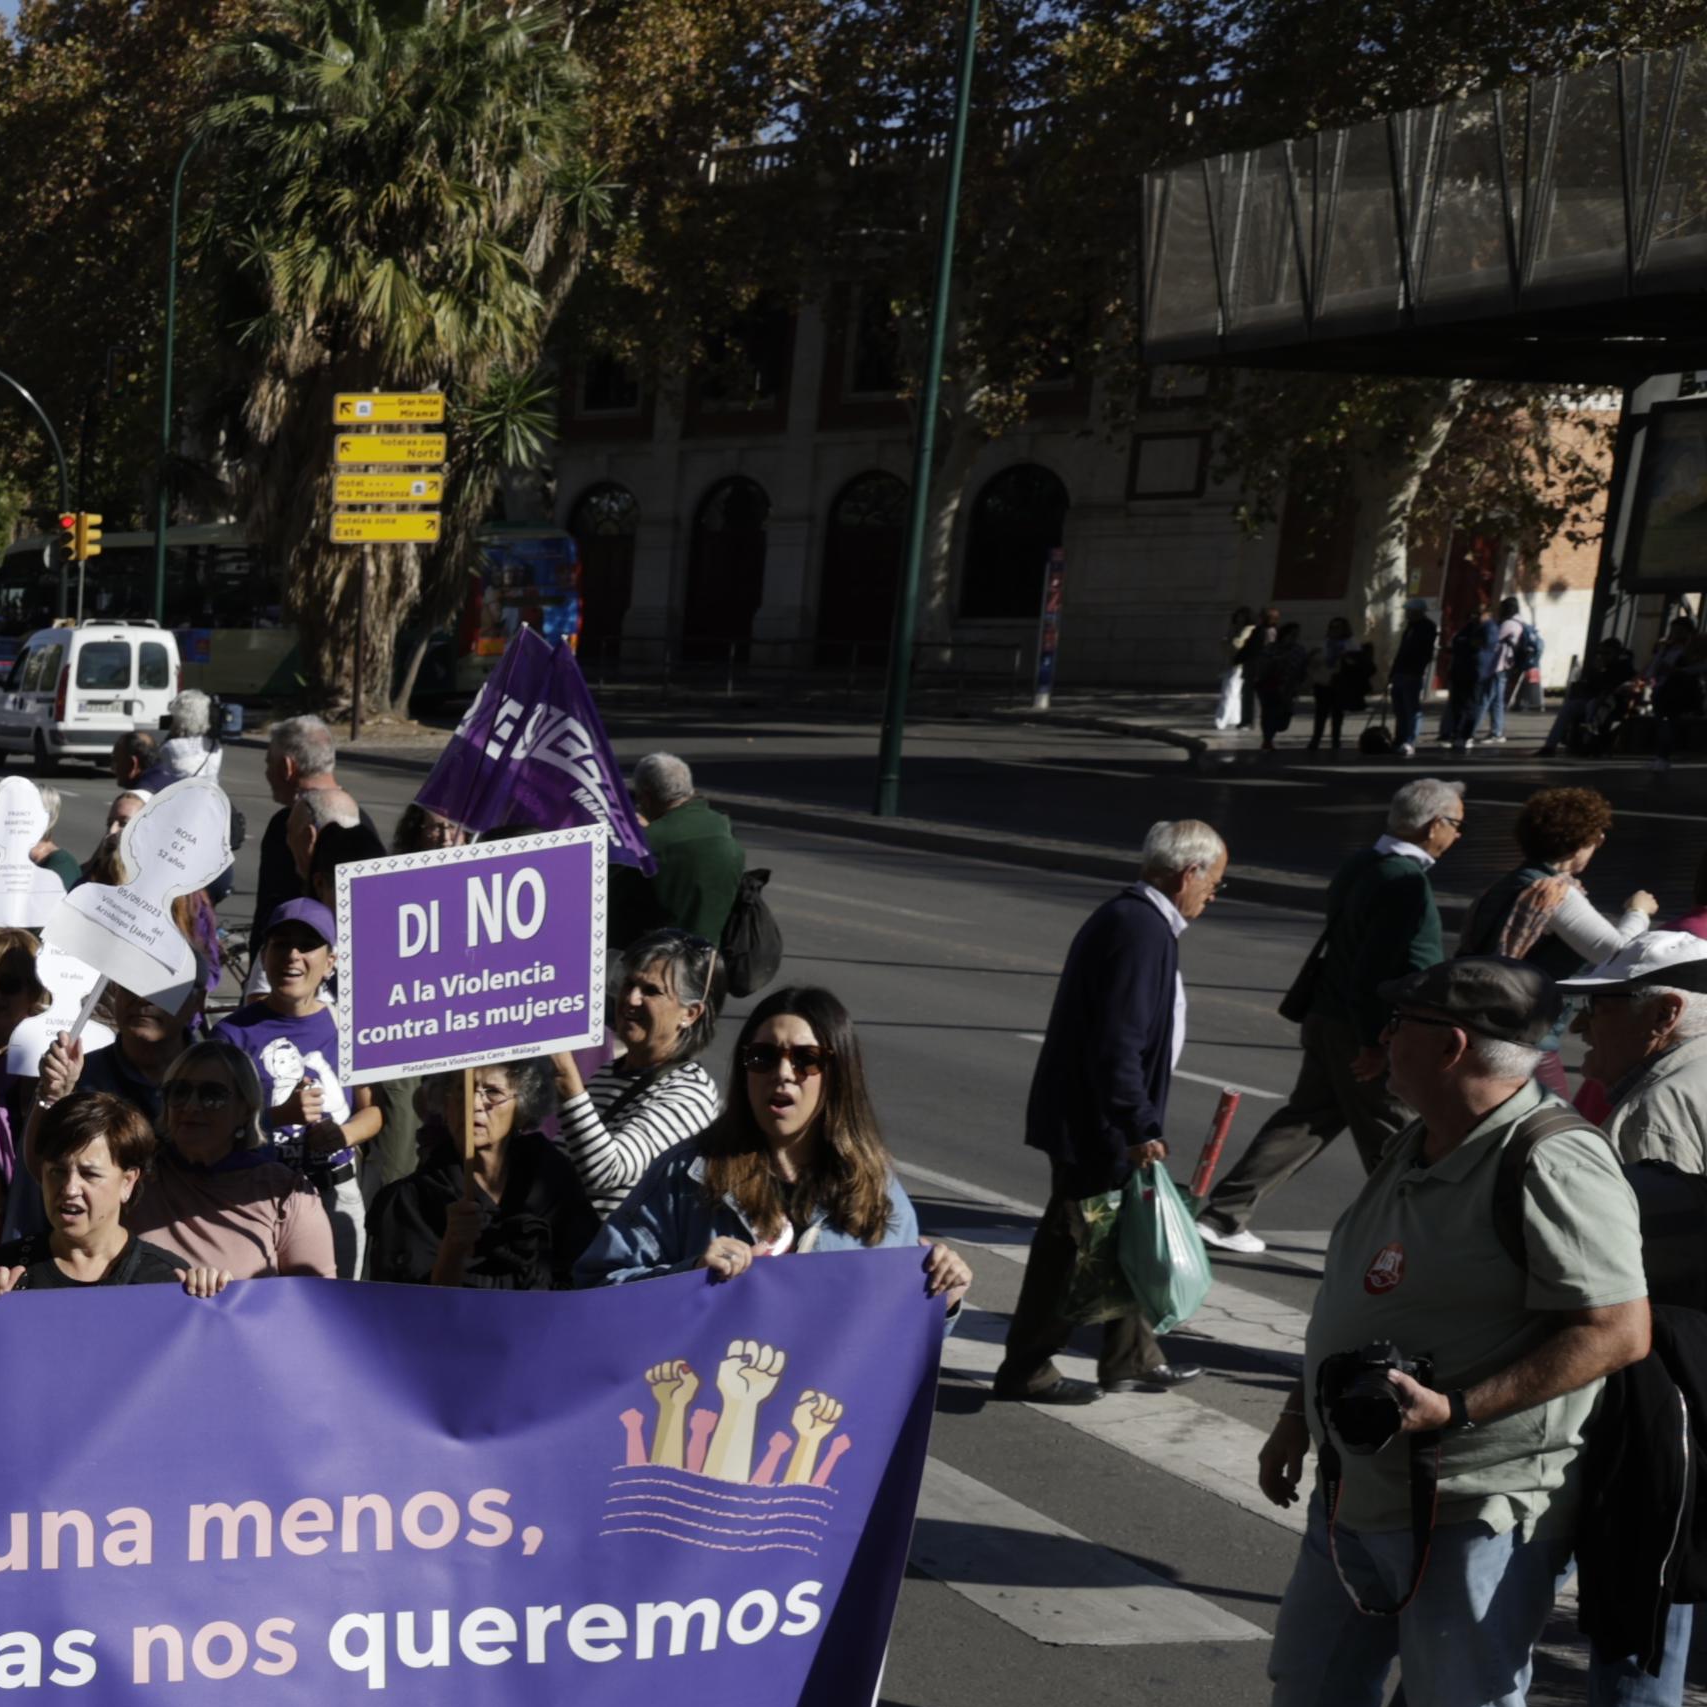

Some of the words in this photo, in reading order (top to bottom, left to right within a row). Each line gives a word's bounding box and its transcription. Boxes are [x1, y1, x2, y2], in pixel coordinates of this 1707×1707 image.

[398, 398, 415, 406] Gran
[417, 398, 440, 406] Hotel
[400, 410, 439, 418] Miramar
[380, 438, 418, 446] hoteles
[407, 449, 441, 458] Norte
[336, 527, 362, 537] Este
[170, 841, 186, 856] G.F.
[175, 827, 197, 845] ROSA
[157, 848, 170, 860] 52
[167, 854, 187, 872] años
[116, 886, 163, 919] 05/09/2023
[398, 900, 439, 959] DI
[467, 867, 546, 948] NO
[102, 895, 137, 922] Villanueva
[151, 926, 164, 938] del
[128, 920, 157, 947] (Jaen)
[389, 984, 407, 1007] A
[414, 980, 436, 1004] la
[441, 961, 555, 998] Violencia
[357, 1017, 439, 1046] contra
[445, 1009, 480, 1033] las
[485, 993, 585, 1026] mujeres
[402, 1058, 447, 1073] Plataforma
[449, 1052, 485, 1067] Violencia
[487, 1050, 506, 1061] Cero
[512, 1045, 542, 1057] Málaga
[187, 1488, 543, 1562] menos,
[131, 1616, 298, 1684] nos
[327, 1579, 823, 1690] queremos
